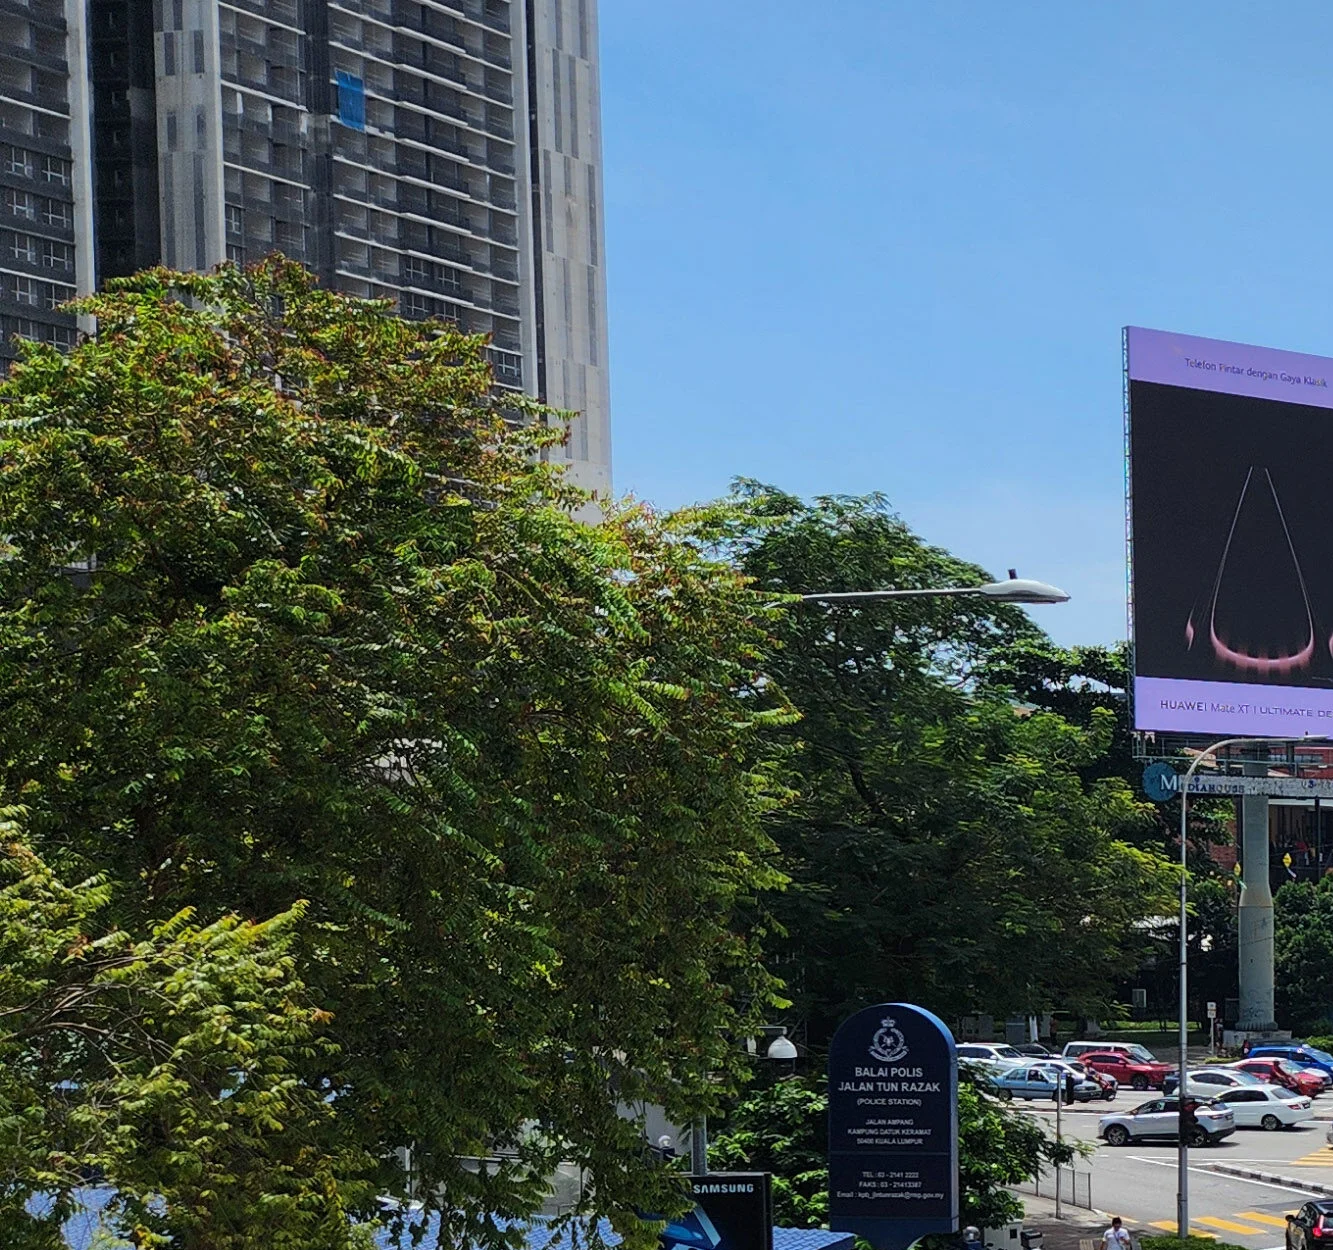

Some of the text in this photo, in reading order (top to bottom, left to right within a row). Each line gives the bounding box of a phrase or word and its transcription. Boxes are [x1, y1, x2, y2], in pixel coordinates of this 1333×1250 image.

[1184, 357, 1328, 388] Telefon Pintar dengan Gaya Klasik
[1160, 700, 1207, 712] HUAWEI
[1210, 702, 1235, 714] Mate
[1238, 704, 1250, 714] XT
[1260, 706, 1313, 717] ULTIMATE
[855, 1067, 923, 1077] BALAI POLIS
[838, 1082, 941, 1092] JALAN TUN RAZAK
[857, 1098, 922, 1106] (POLICE STATION)
[693, 1183, 754, 1194] SAMSUNG
